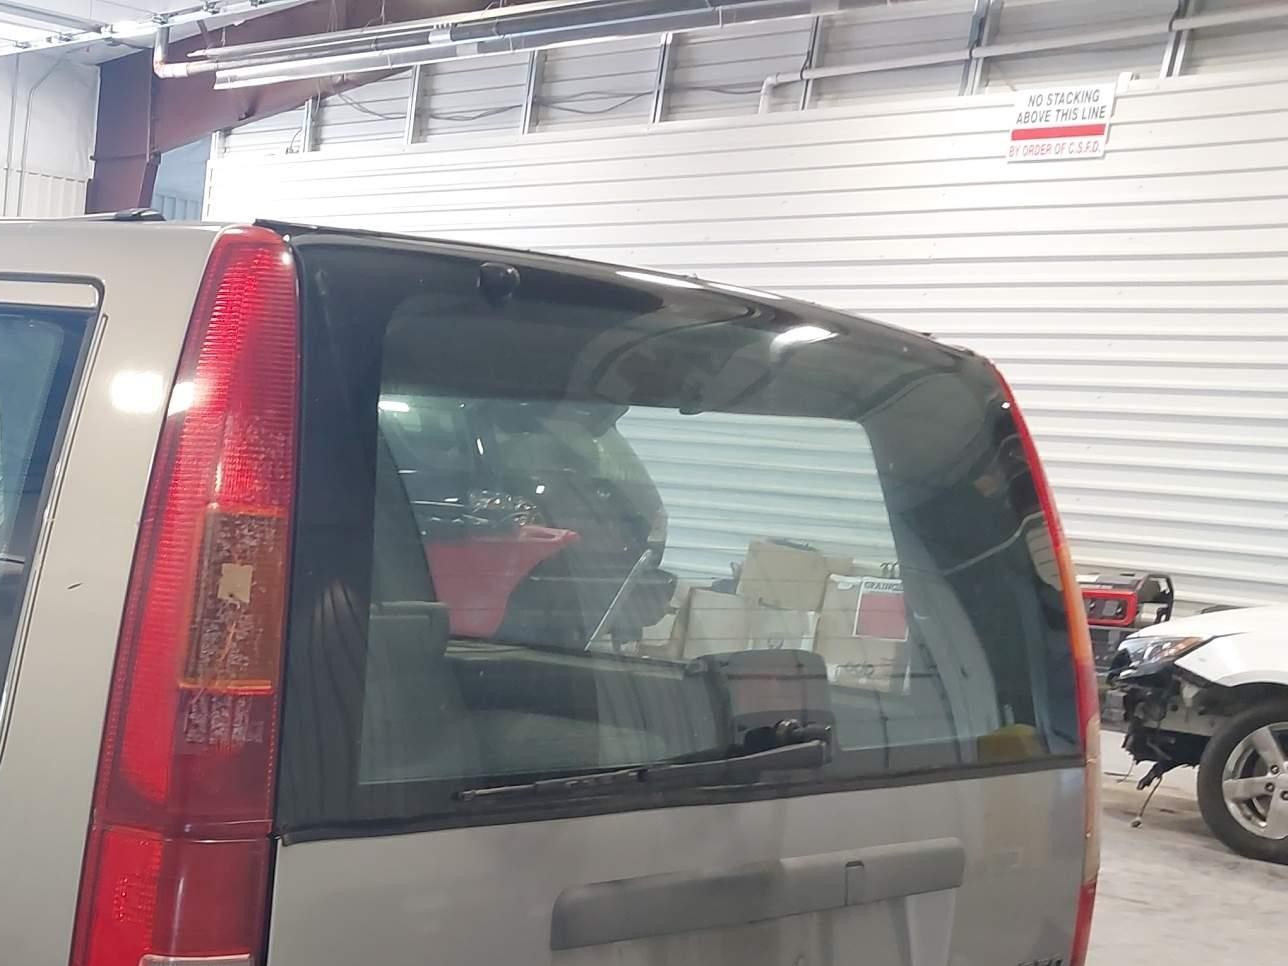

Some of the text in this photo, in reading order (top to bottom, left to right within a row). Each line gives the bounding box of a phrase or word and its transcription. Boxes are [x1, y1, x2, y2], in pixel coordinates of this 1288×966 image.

[1028, 89, 1101, 107] NO STACKING
[1016, 105, 1107, 125] ABOVE THIS LINE
[1009, 145, 1021, 158] BY
[1022, 143, 1052, 157] ORDER
[1054, 142, 1067, 156] OF
